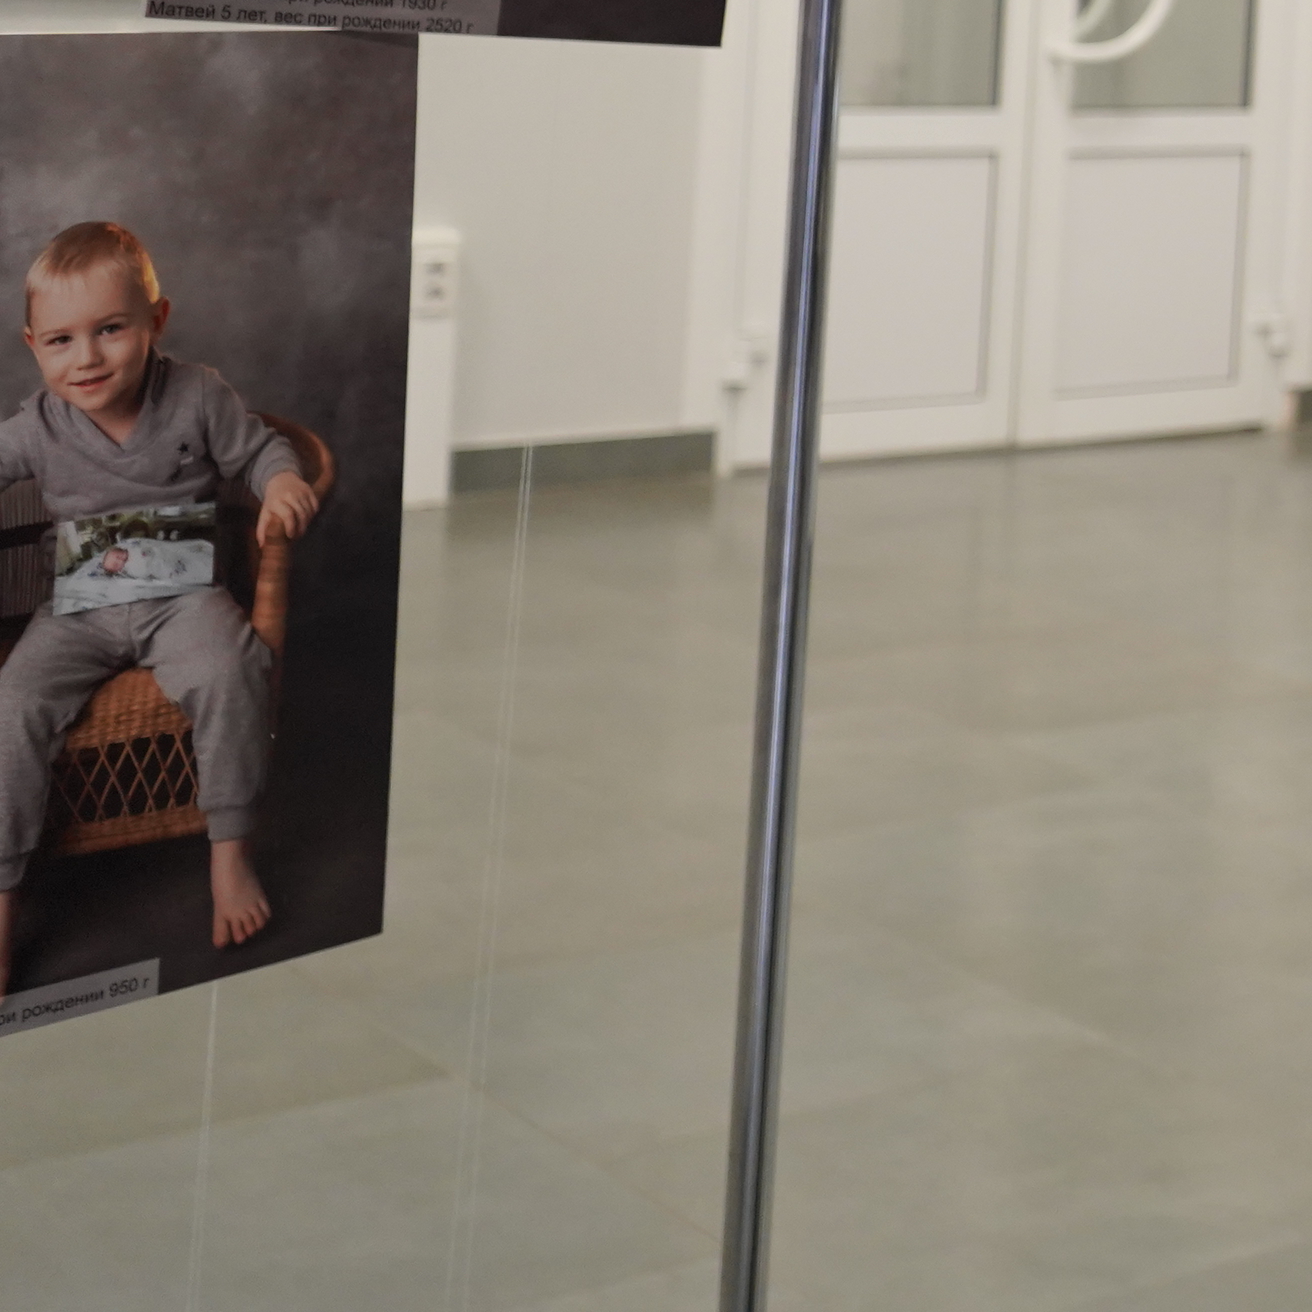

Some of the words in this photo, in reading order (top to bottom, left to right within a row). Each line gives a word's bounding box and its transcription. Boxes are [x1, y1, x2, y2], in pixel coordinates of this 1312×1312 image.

[150, 0, 216, 19] Матвей
[220, 4, 231, 19] 5
[236, 8, 268, 24] лет,
[274, 11, 305, 24] вес
[307, 12, 337, 26] при
[341, 13, 421, 31] рождении
[425, 17, 463, 33] 2520
[21, 989, 104, 1022] рождении
[109, 977, 138, 998] 950
[142, 977, 150, 988] г
